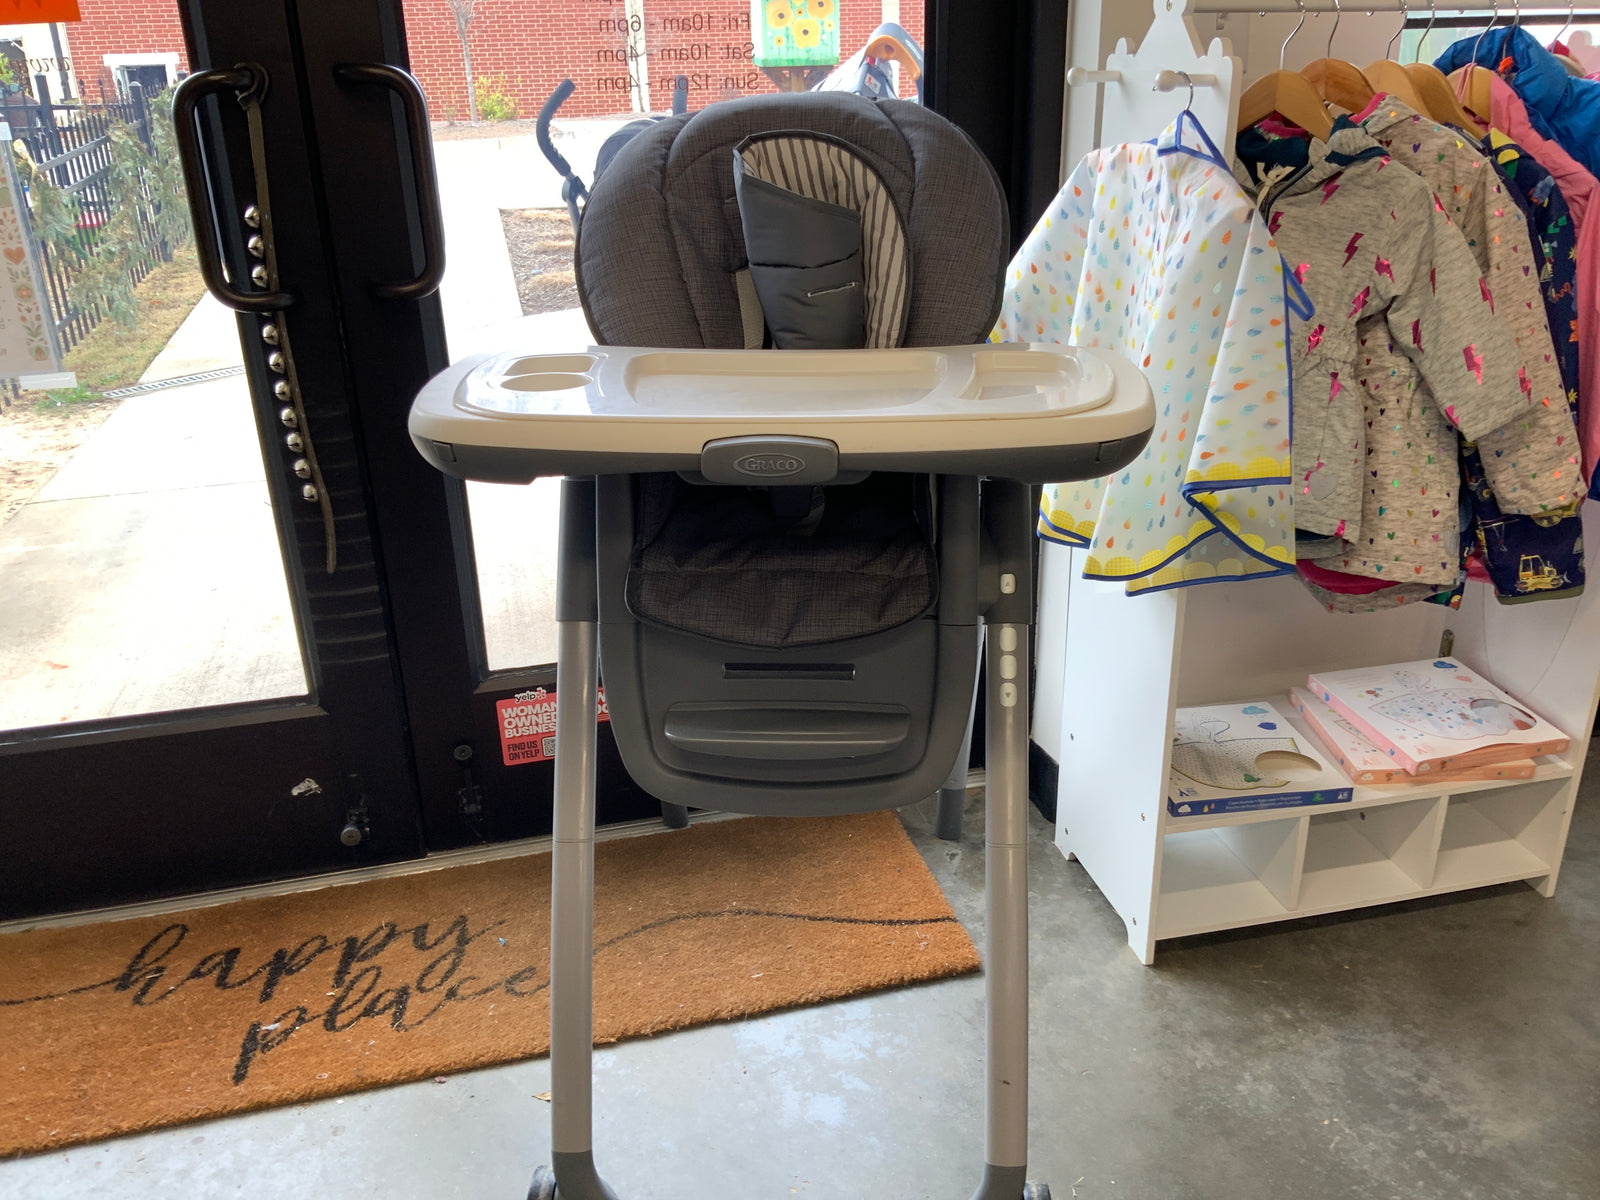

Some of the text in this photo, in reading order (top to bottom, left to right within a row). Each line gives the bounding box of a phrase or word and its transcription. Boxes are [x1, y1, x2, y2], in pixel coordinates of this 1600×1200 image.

[744, 458, 798, 471] GRACO
[516, 692, 536, 703] yelp
[505, 723, 556, 739] BUSINES
[508, 740, 538, 752] FIND US
[509, 749, 539, 761] ON YELP
[115, 915, 504, 1006] happy
[231, 965, 550, 1086] place
